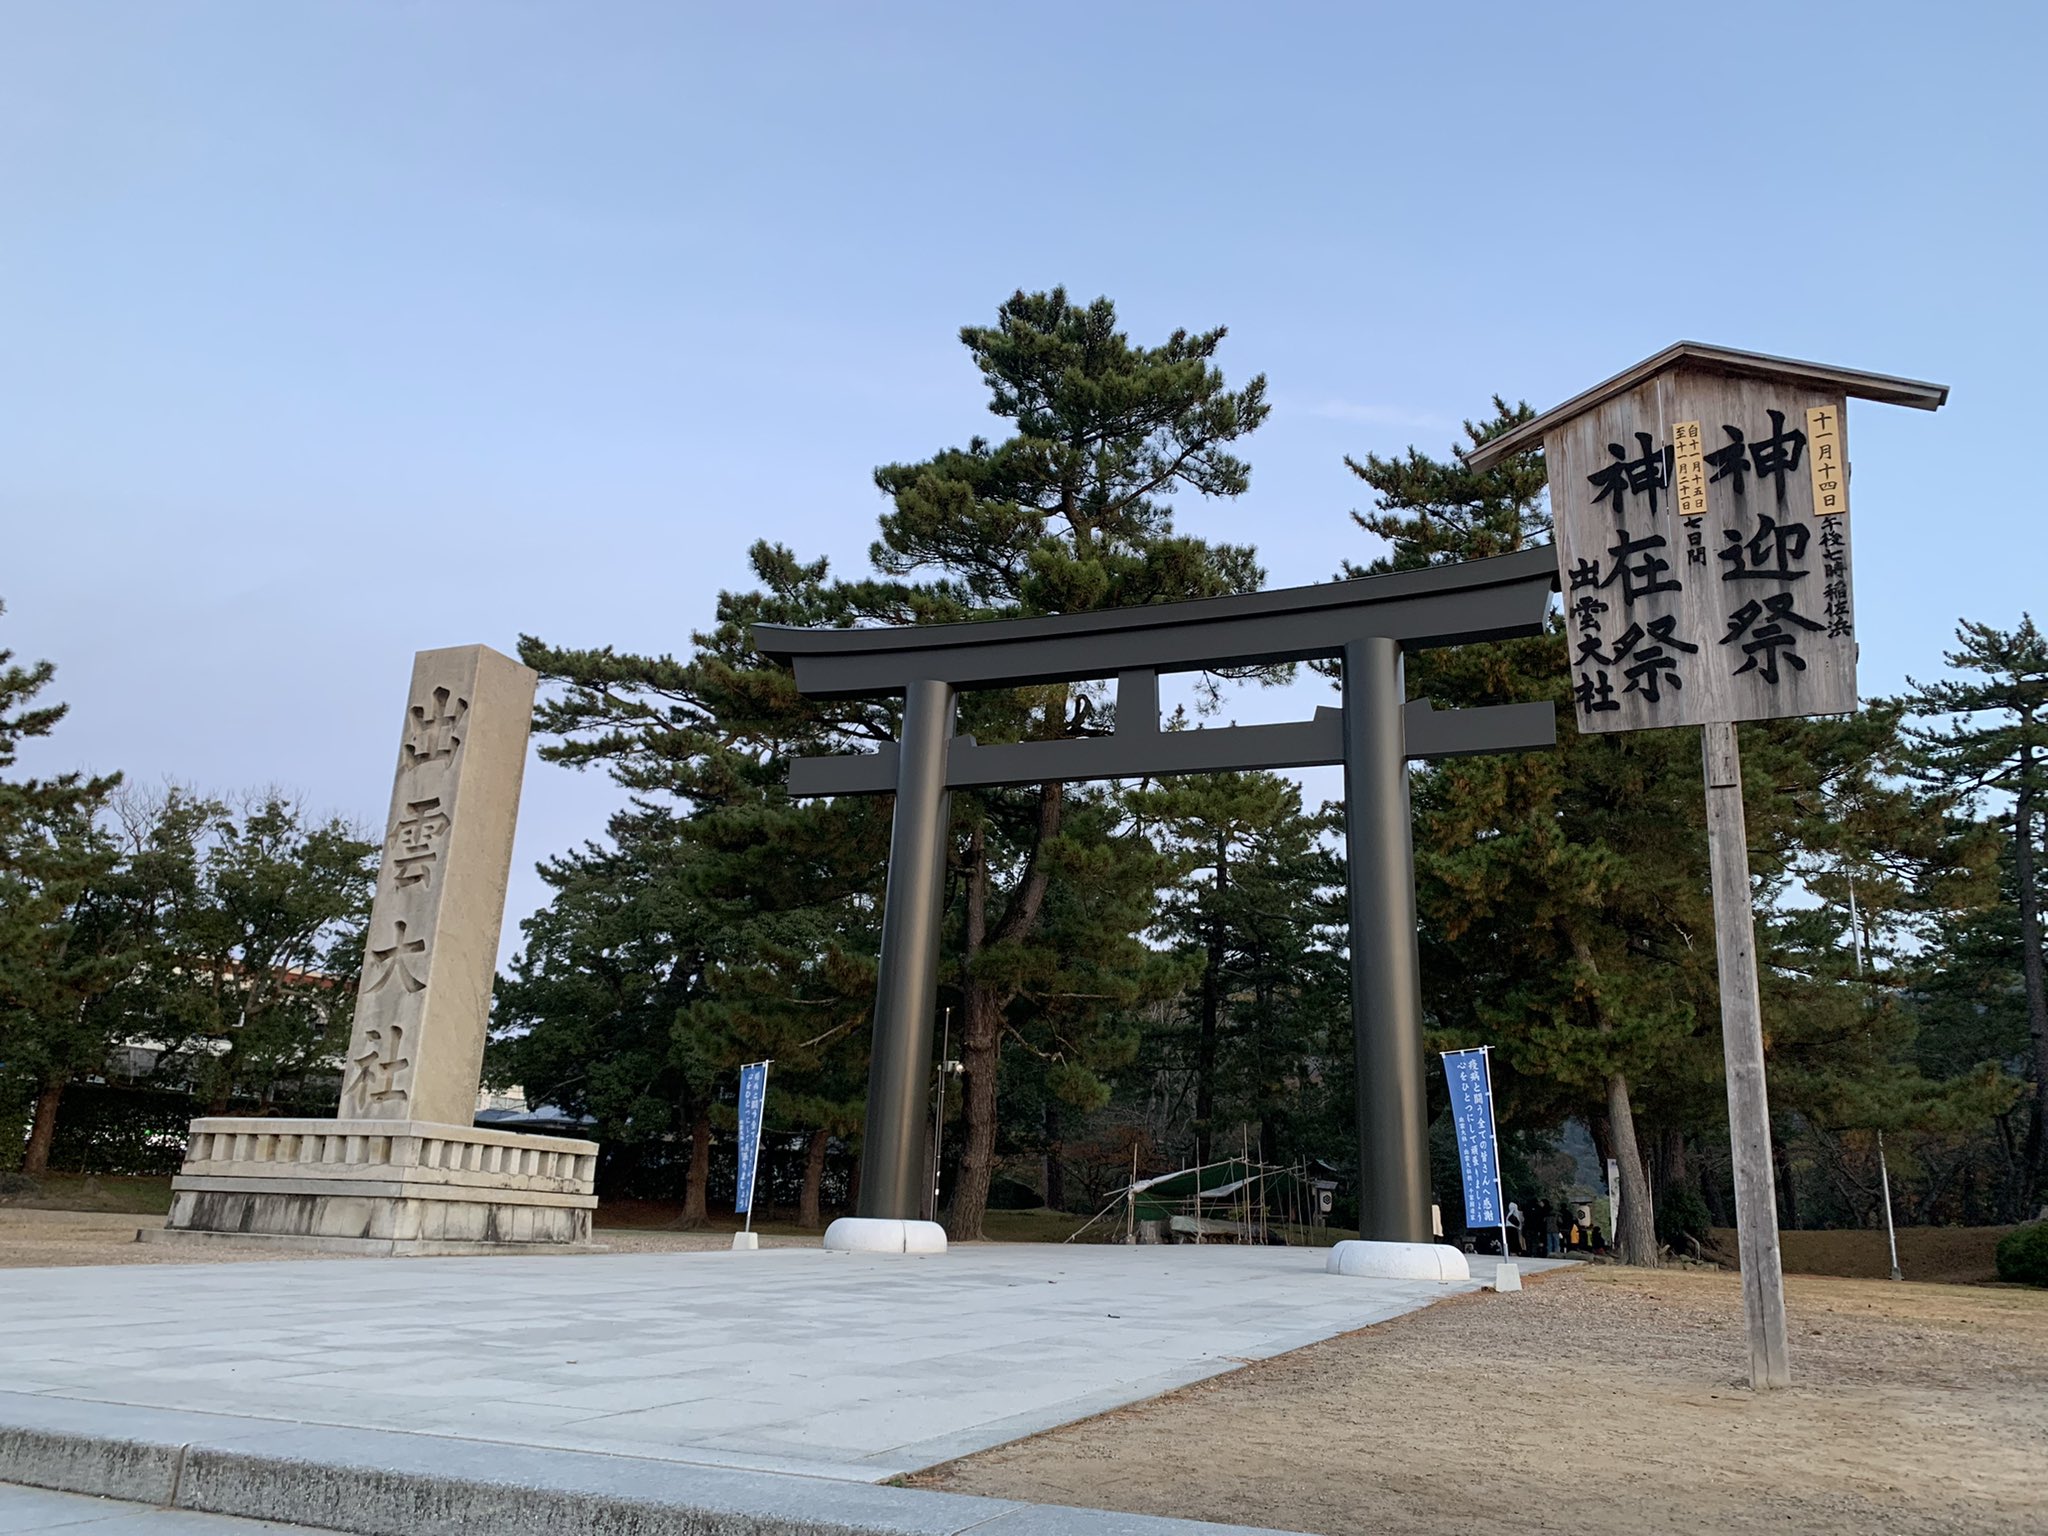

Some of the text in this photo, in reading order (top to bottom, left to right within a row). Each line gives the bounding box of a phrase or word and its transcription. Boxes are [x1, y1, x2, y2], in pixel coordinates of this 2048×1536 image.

[1675, 426, 1691, 510] 至十一月二十一日
[1688, 424, 1704, 508] 自十一月十五日
[1813, 412, 1837, 507] 十一月十四日
[1587, 432, 1698, 703] 神在祭
[1683, 516, 1707, 566] 七日間
[1704, 409, 1827, 684] 神迎祭
[1569, 558, 1620, 714] 出雲大社
[344, 686, 468, 1111] 出雲大社
